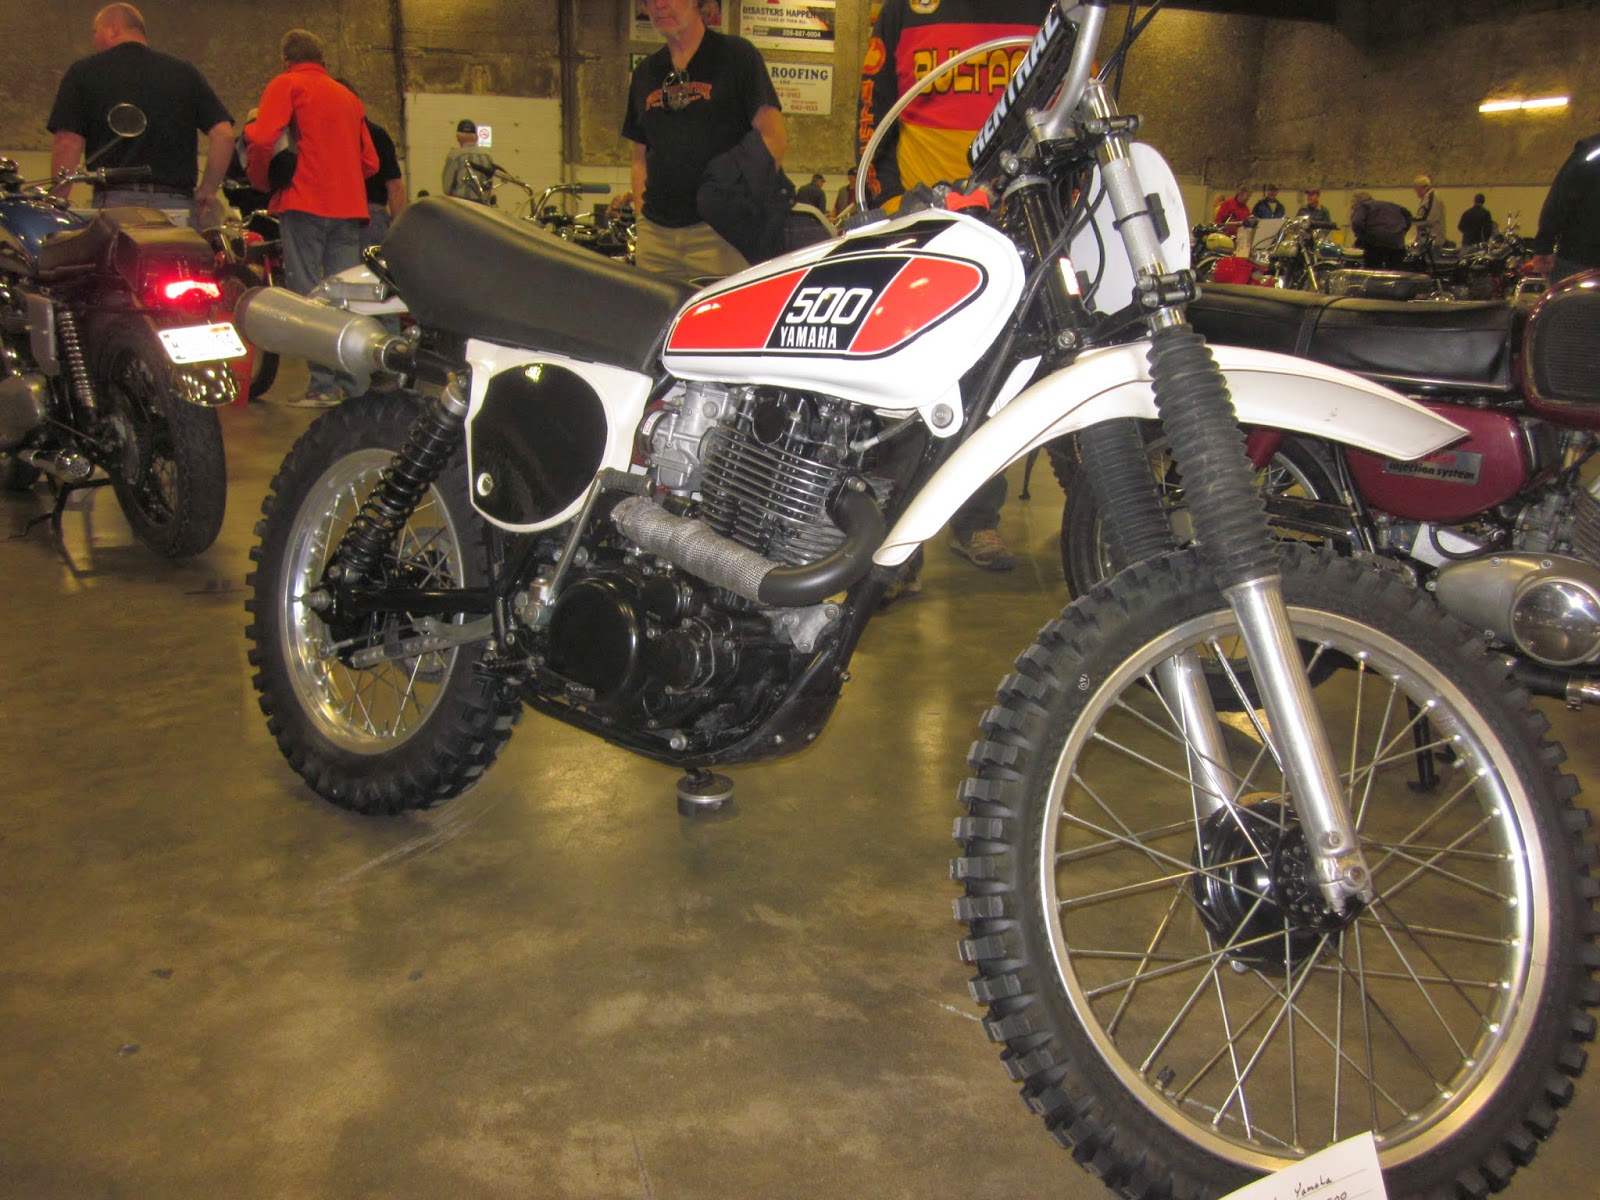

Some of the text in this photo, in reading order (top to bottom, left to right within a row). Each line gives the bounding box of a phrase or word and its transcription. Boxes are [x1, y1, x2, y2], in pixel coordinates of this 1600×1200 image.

[742, 6, 784, 17] DISASTERS
[771, 66, 829, 81] ROOFING
[971, 15, 1061, 164] RENTHAL
[785, 286, 874, 325] 500
[780, 325, 837, 349] YAMAHA
[1388, 461, 1476, 480] injection system
[1294, 1175, 1333, 1199] Yamaha
